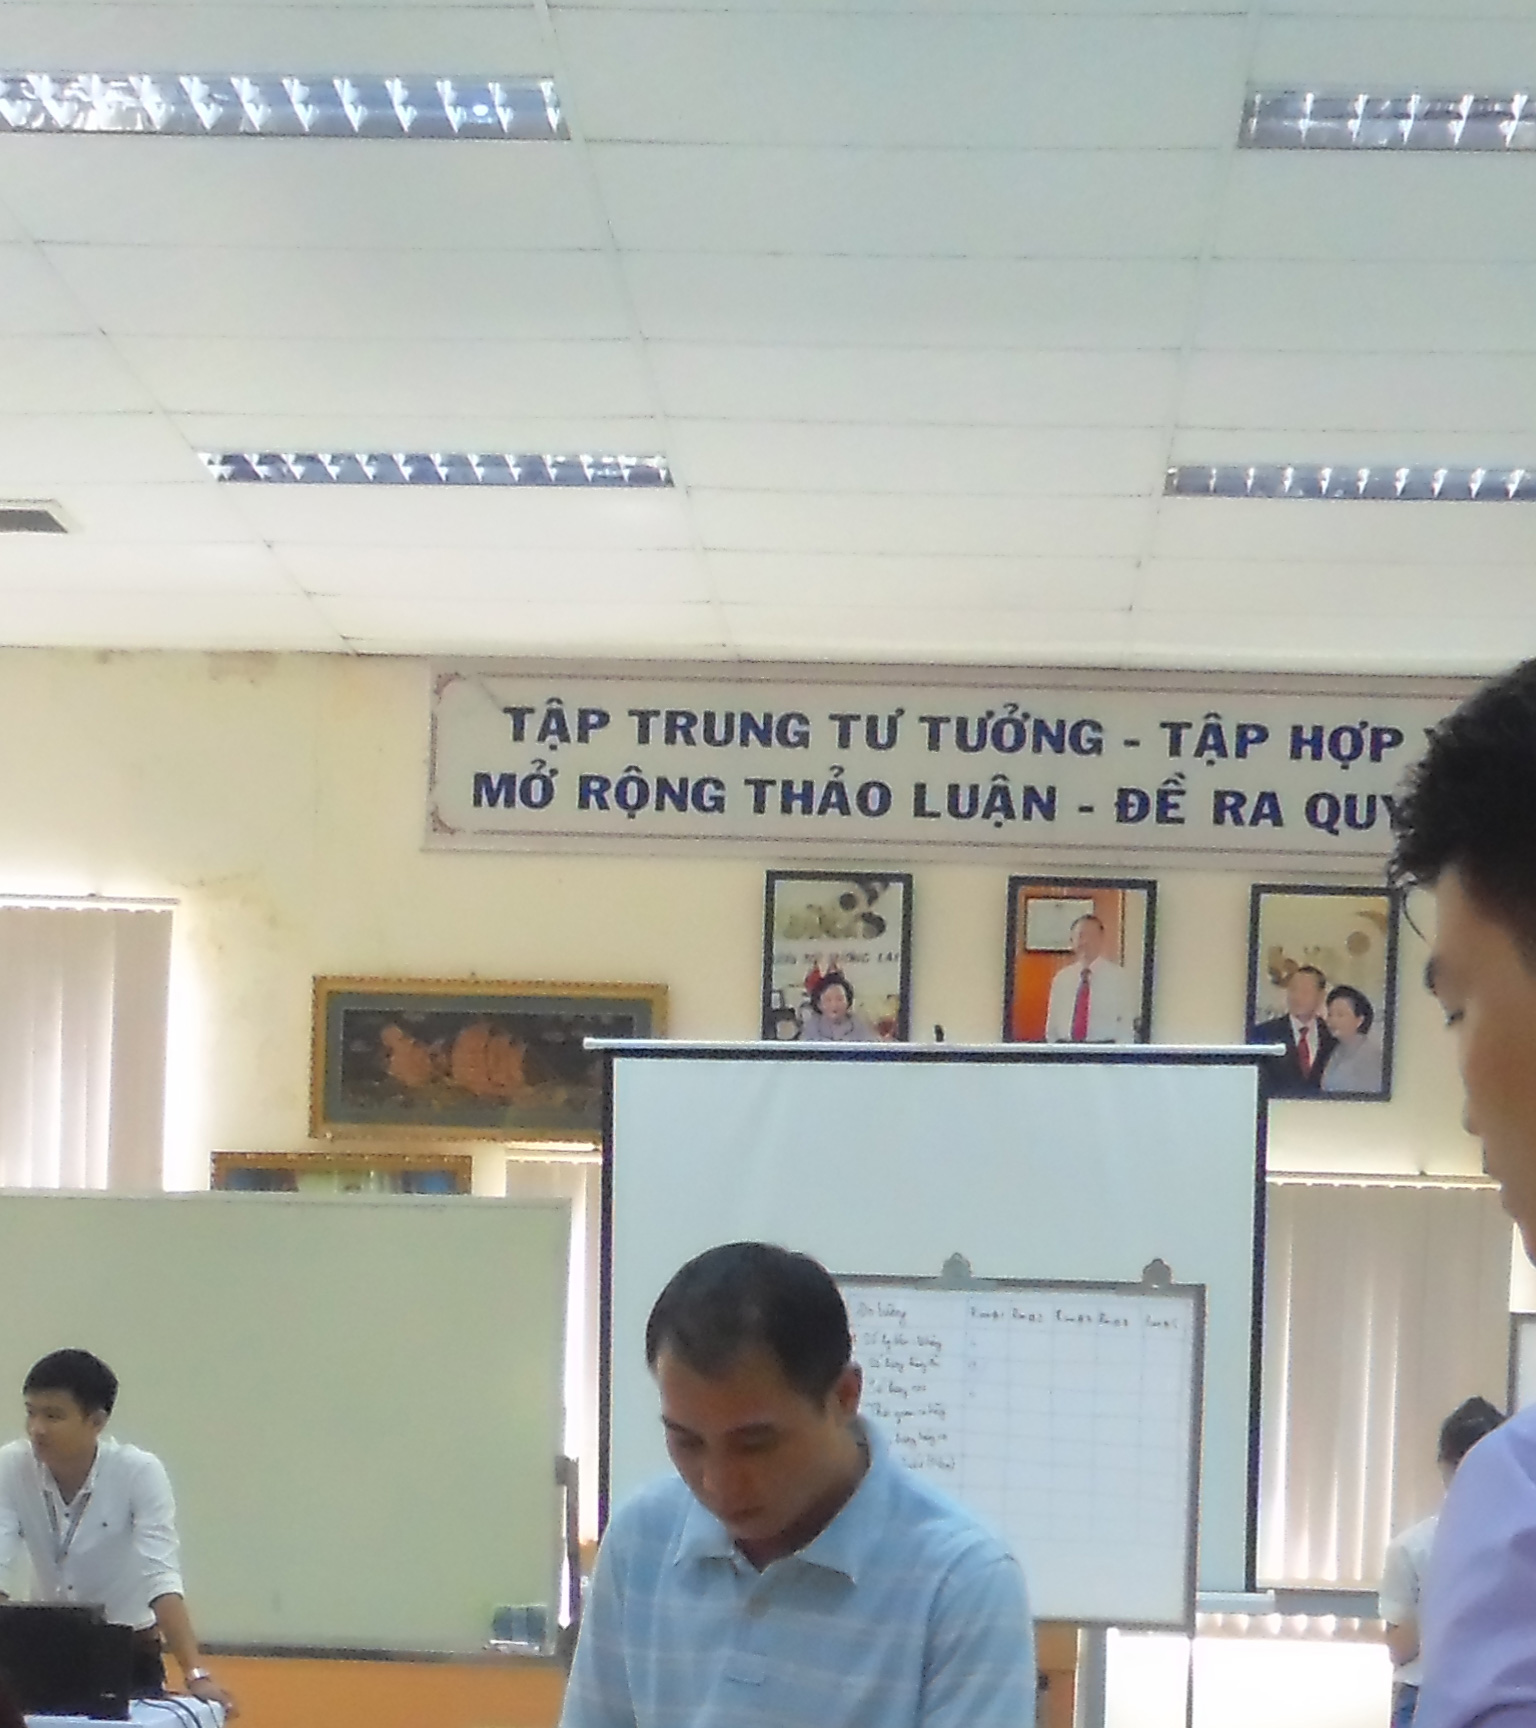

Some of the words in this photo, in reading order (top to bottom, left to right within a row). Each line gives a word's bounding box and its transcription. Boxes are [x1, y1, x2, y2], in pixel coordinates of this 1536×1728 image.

[502, 697, 611, 751] TẬP
[627, 708, 811, 749] TRUNG
[828, 707, 906, 751] TƯ
[918, 702, 1105, 757] TƯỞNG
[1124, 738, 1141, 748] -
[1159, 711, 1270, 766] TẬP
[1289, 721, 1405, 770] HỢP
[472, 757, 560, 810] MỞ
[577, 764, 725, 820] RỘNG
[744, 764, 893, 818] THẢO
[913, 773, 1057, 829] LUẬN
[1077, 804, 1095, 814] -
[1114, 771, 1187, 826] ĐỀ
[1212, 789, 1285, 828] RA
